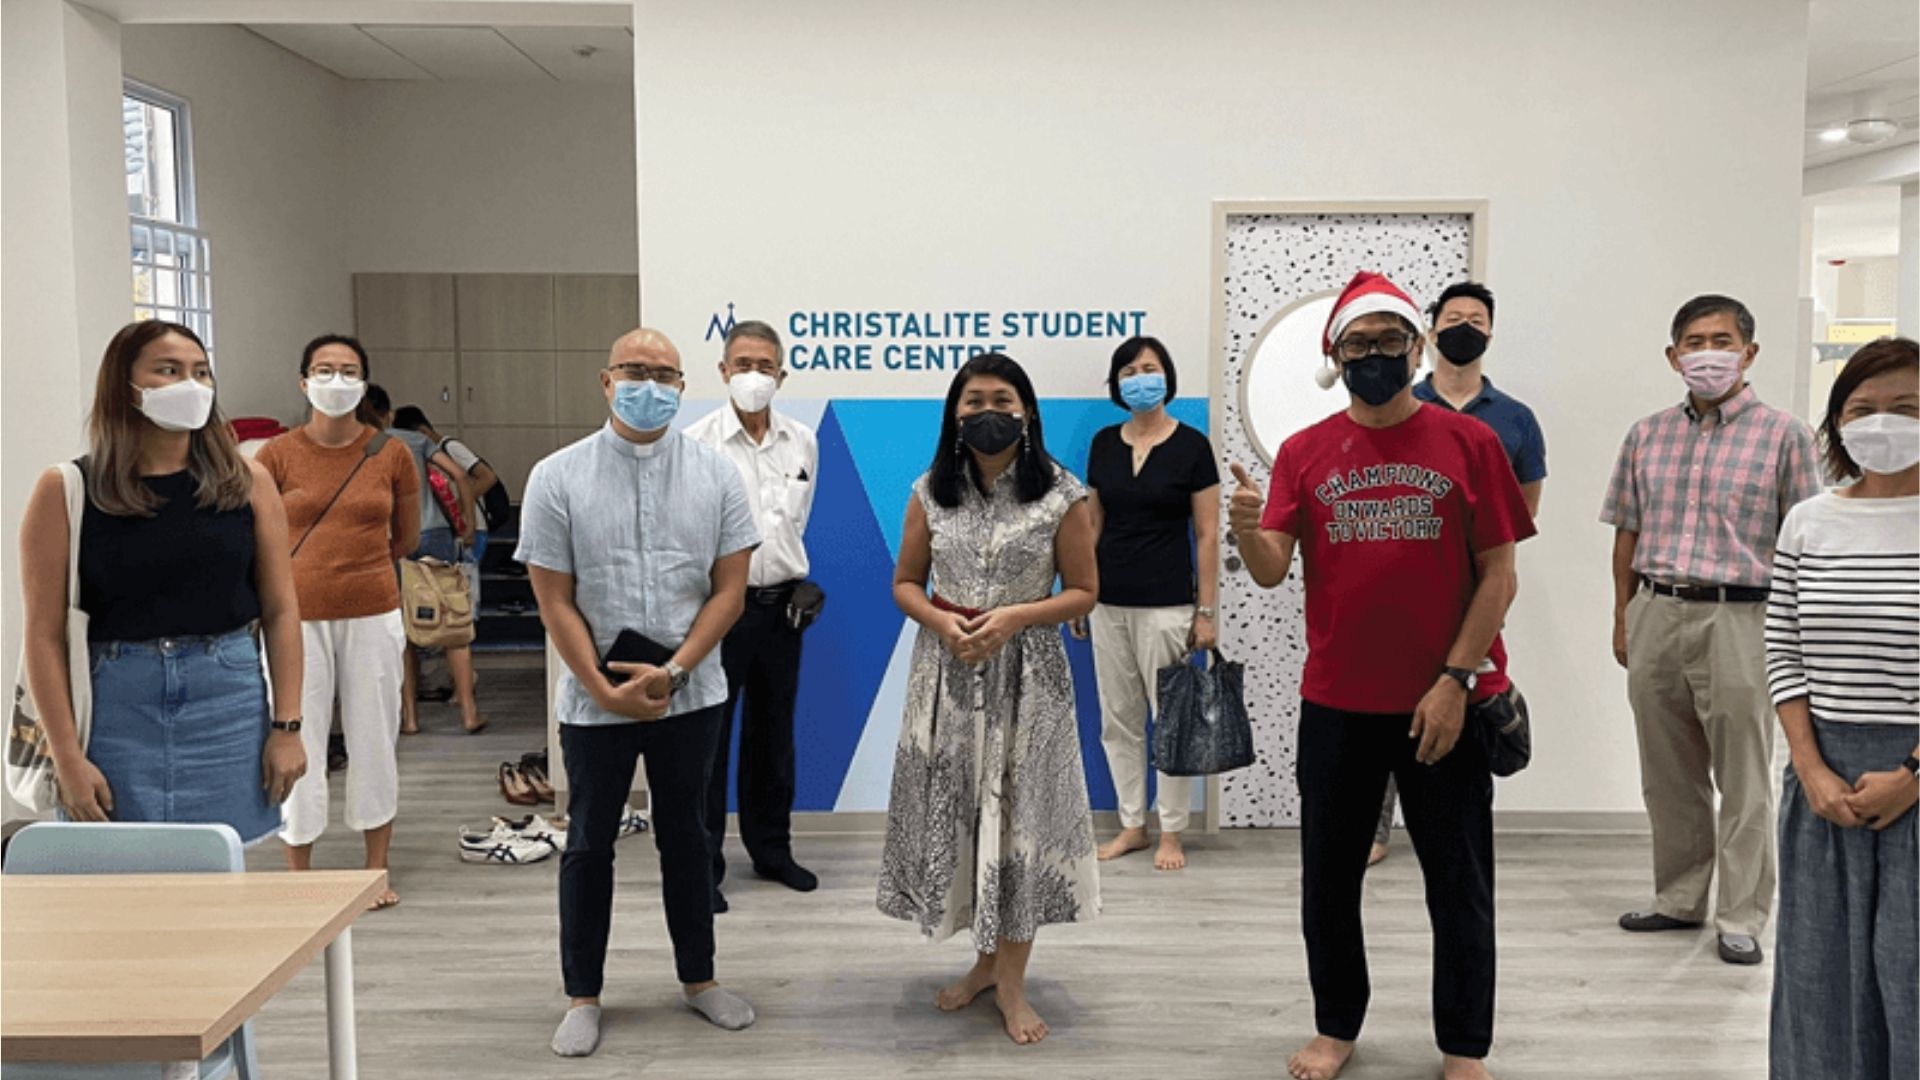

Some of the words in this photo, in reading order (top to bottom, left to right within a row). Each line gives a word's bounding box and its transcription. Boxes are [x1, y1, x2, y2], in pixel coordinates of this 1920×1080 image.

[789, 311, 989, 338] CHRISTALITE
[1002, 311, 1147, 338] STUDENT
[789, 344, 872, 370] CARE
[1316, 463, 1452, 506] CHAMPIONS
[1334, 496, 1433, 521] ONWARDS
